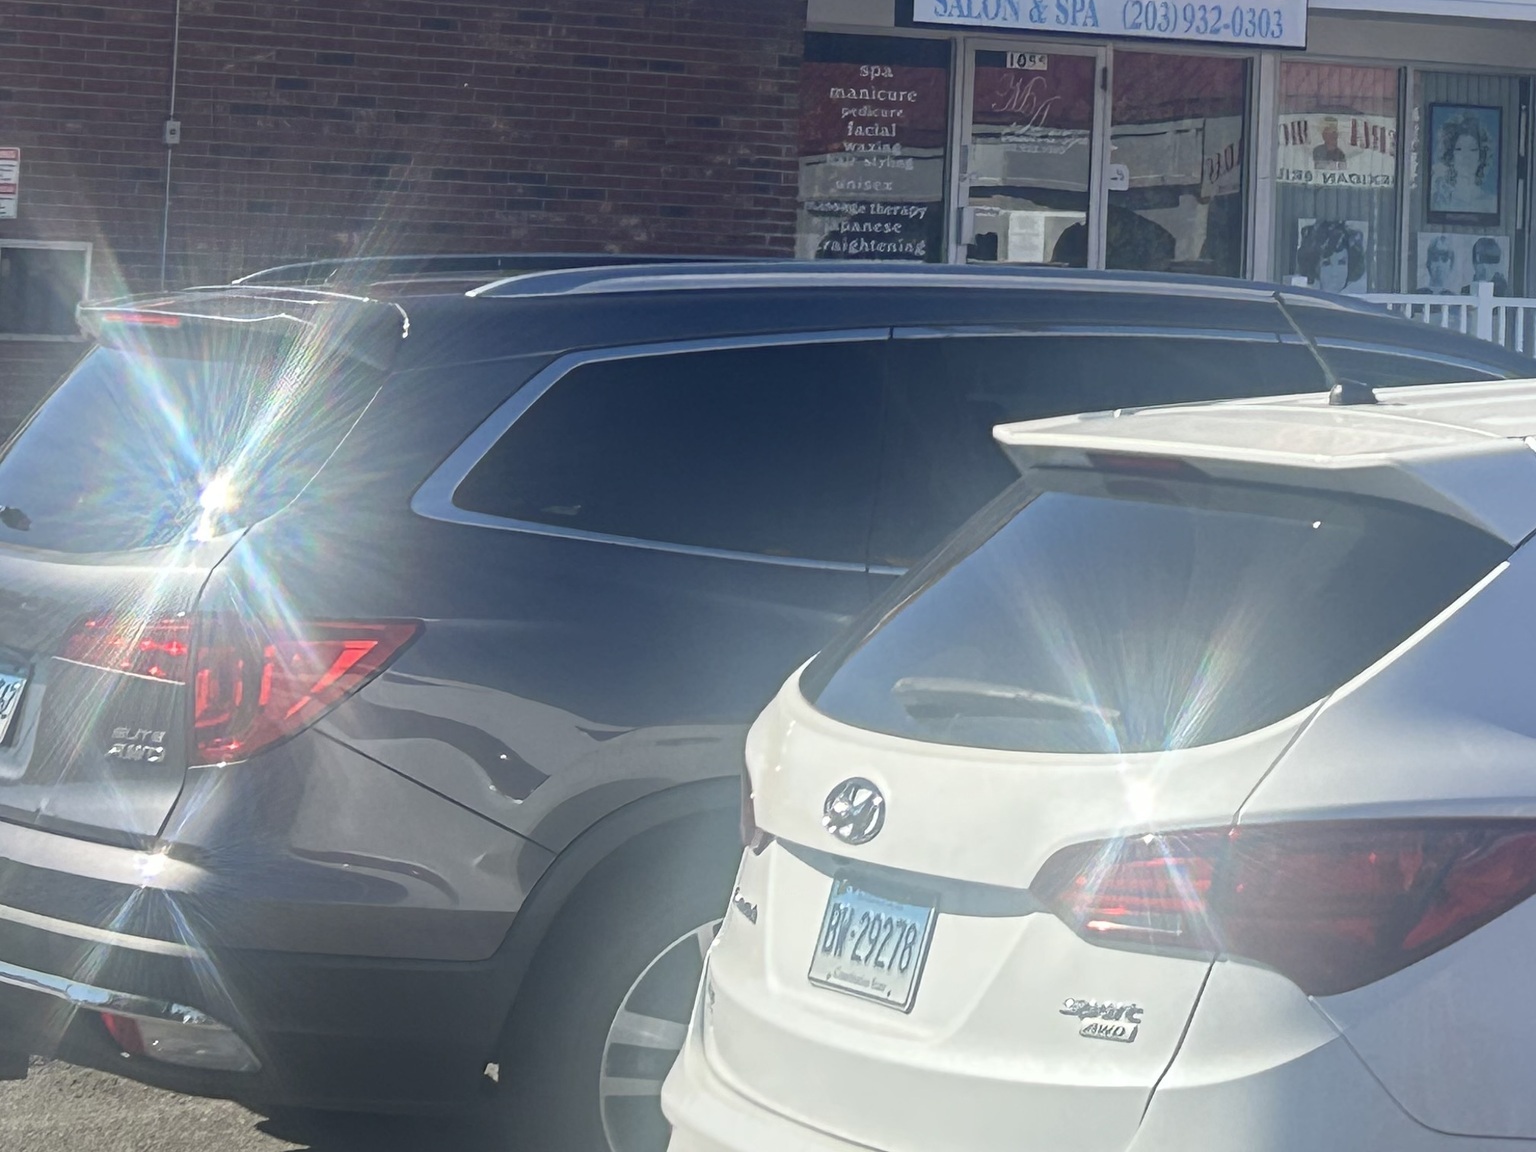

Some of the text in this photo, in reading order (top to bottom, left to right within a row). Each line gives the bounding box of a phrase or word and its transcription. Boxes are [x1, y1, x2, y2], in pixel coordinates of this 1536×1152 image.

[860, 64, 894, 80] spa
[829, 86, 918, 102] manicure
[841, 105, 904, 119] pedicure
[847, 120, 897, 137] facial
[842, 141, 903, 156] waxing
[836, 179, 894, 192] unisex
[870, 202, 928, 220] therapy
[1082, 1022, 1126, 1037] AWD
